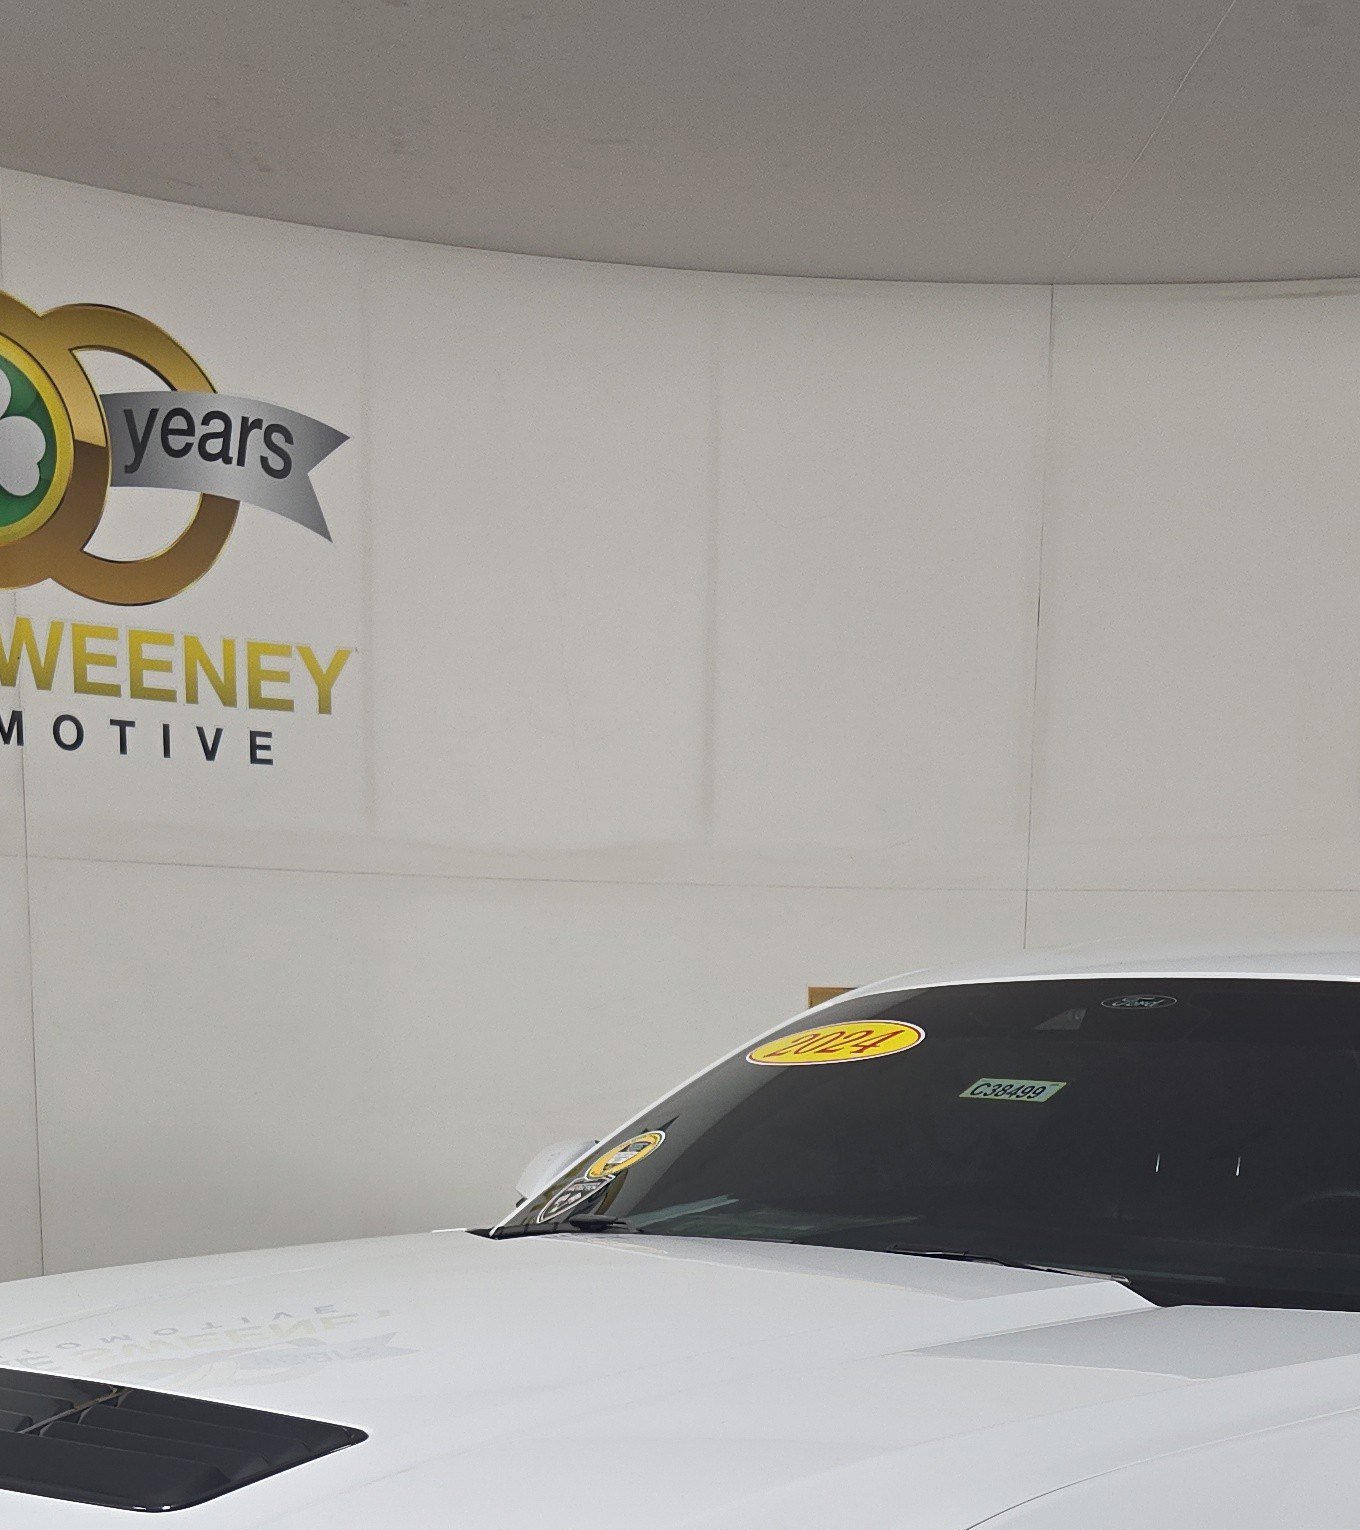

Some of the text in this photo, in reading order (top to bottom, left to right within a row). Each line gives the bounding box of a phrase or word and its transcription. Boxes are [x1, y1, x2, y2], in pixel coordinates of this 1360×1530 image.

[123, 406, 295, 480] years
[763, 1029, 906, 1059] 2024
[969, 1082, 1047, 1100] C38499
